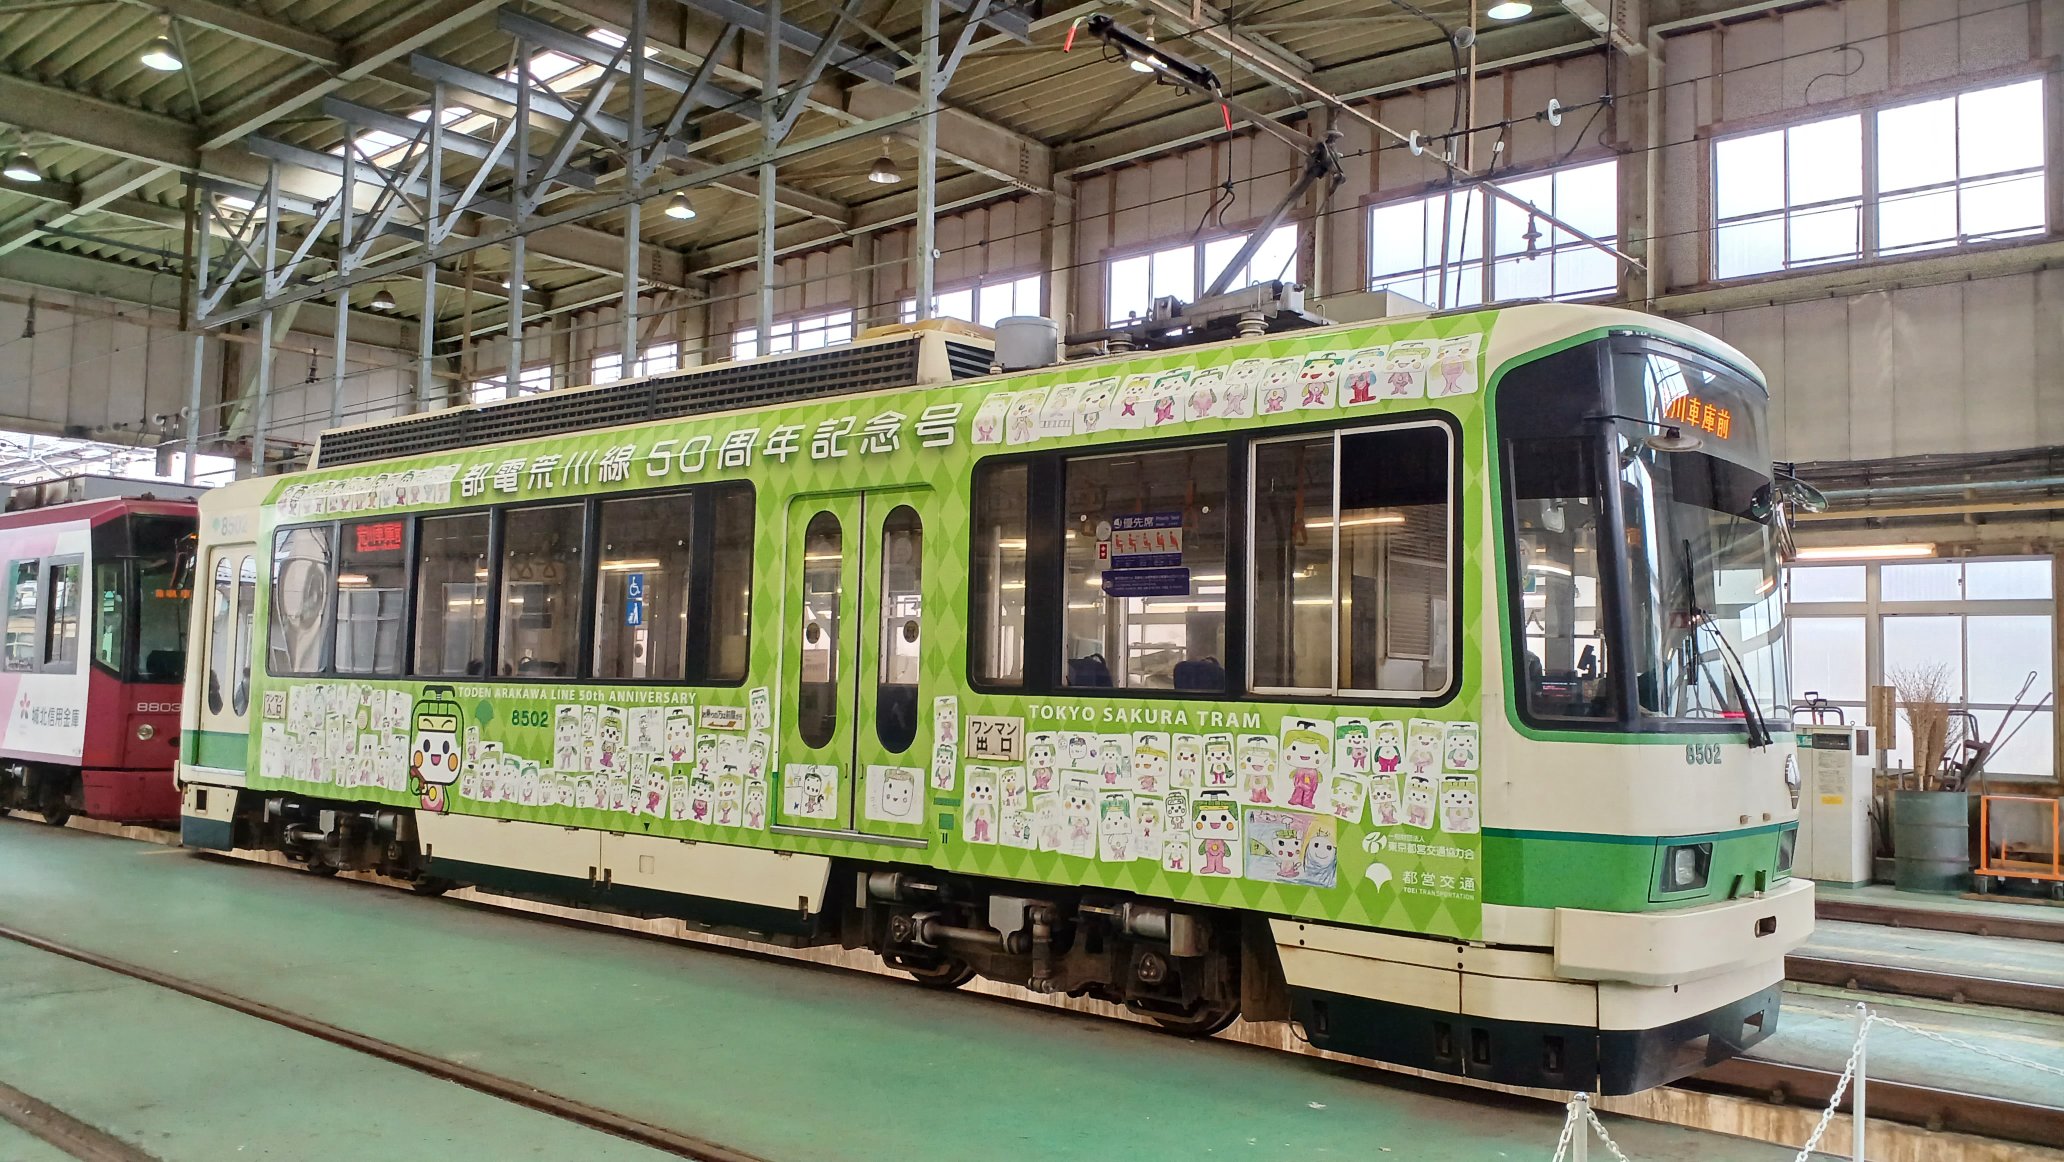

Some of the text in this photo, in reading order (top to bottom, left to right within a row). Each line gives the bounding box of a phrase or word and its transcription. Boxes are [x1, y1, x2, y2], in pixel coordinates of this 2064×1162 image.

[1663, 395, 1731, 440] 川車庫前
[458, 686, 697, 704] TODEN ARAKAWA LINE 50th ANNIVERSARY
[31, 706, 80, 728] 城北信用金庫
[137, 702, 182, 713] 8803
[1029, 704, 1261, 729] TOKYO SAKURA TRAM
[511, 709, 549, 728] 8502
[971, 720, 1018, 736] ワンマン
[975, 736, 1013, 753] 出口
[1685, 742, 1722, 765] 8502
[1388, 842, 1474, 860] 東京都営交通協力会
[1403, 871, 1475, 891] 都営交通
